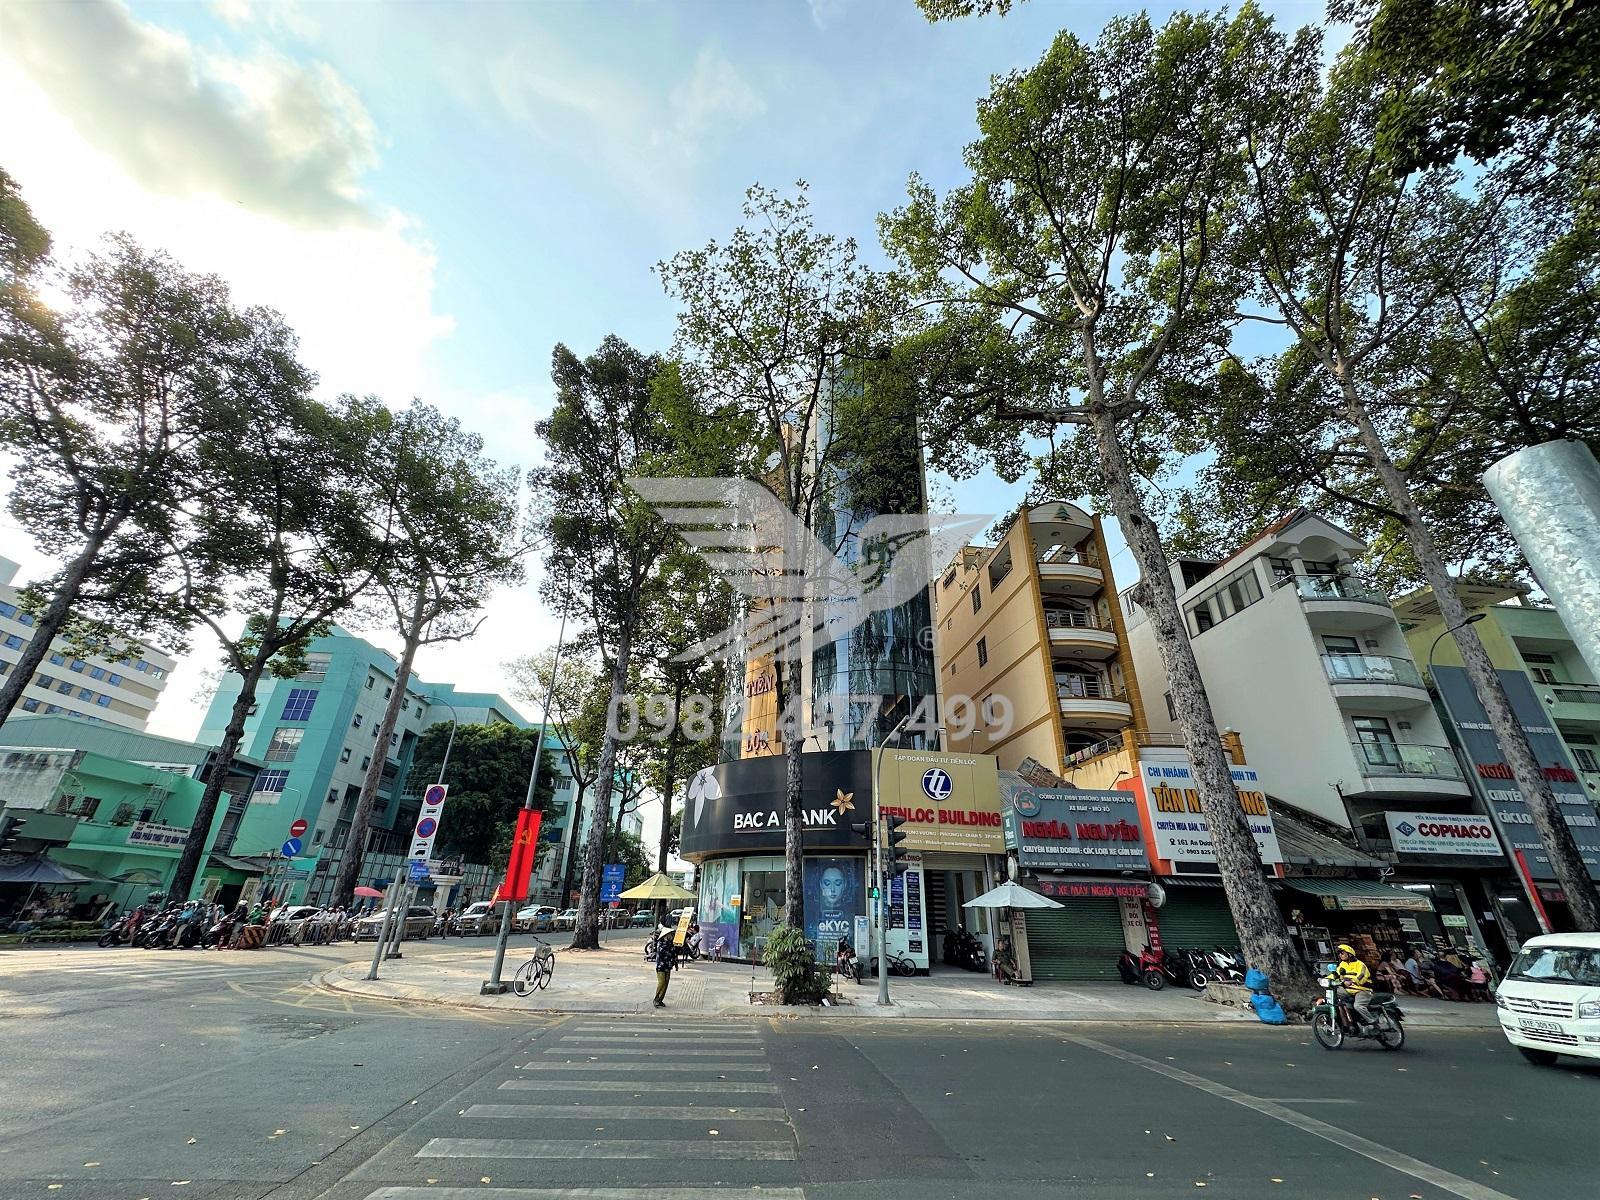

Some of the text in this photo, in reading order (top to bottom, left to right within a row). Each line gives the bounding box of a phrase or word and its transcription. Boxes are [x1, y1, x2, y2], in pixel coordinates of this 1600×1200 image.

[1147, 766, 1190, 778] CHI NHÁNH
[1151, 781, 1186, 813] TÂN
[733, 811, 764, 829] BAC
[766, 810, 780, 827] A
[938, 809, 1002, 827] BUILDING
[1418, 823, 1492, 839] COPHACO
[1058, 886, 1068, 895] XE
[818, 920, 850, 932] eKYC
